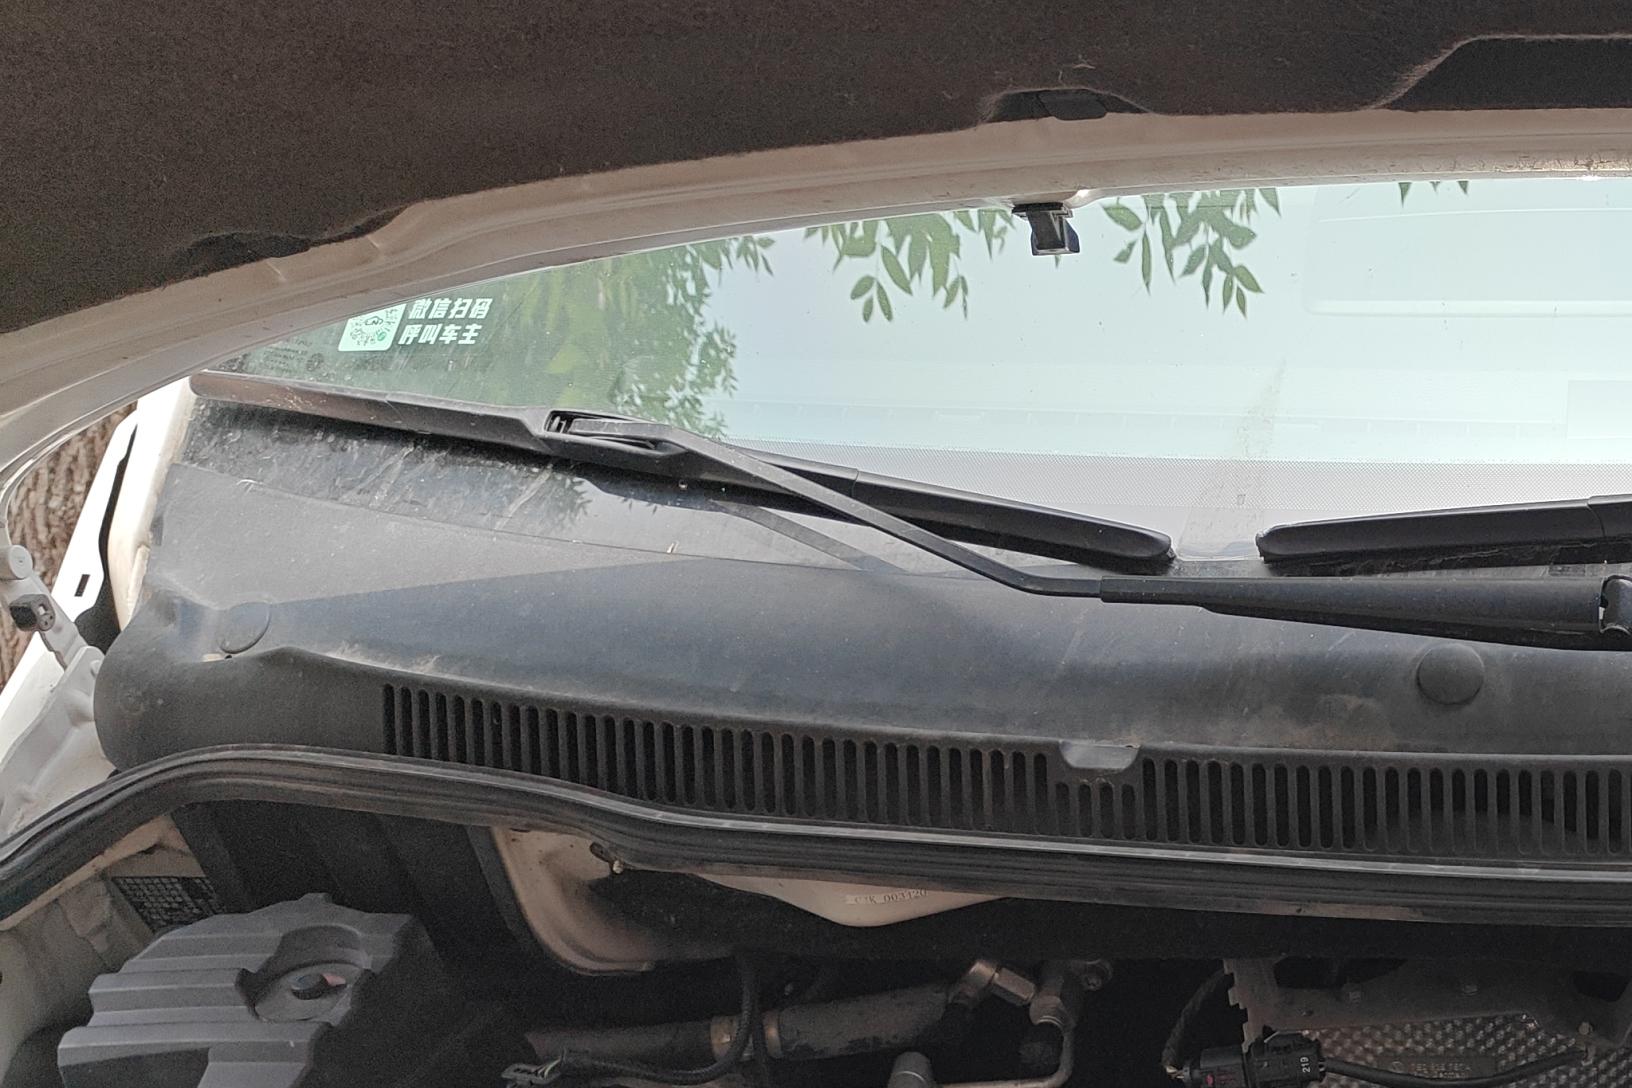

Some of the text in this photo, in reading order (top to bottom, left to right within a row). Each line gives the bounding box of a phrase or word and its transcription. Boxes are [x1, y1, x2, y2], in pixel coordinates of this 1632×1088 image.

[408, 298, 493, 319] 微信扫码
[398, 324, 482, 345] 呼叫车主
